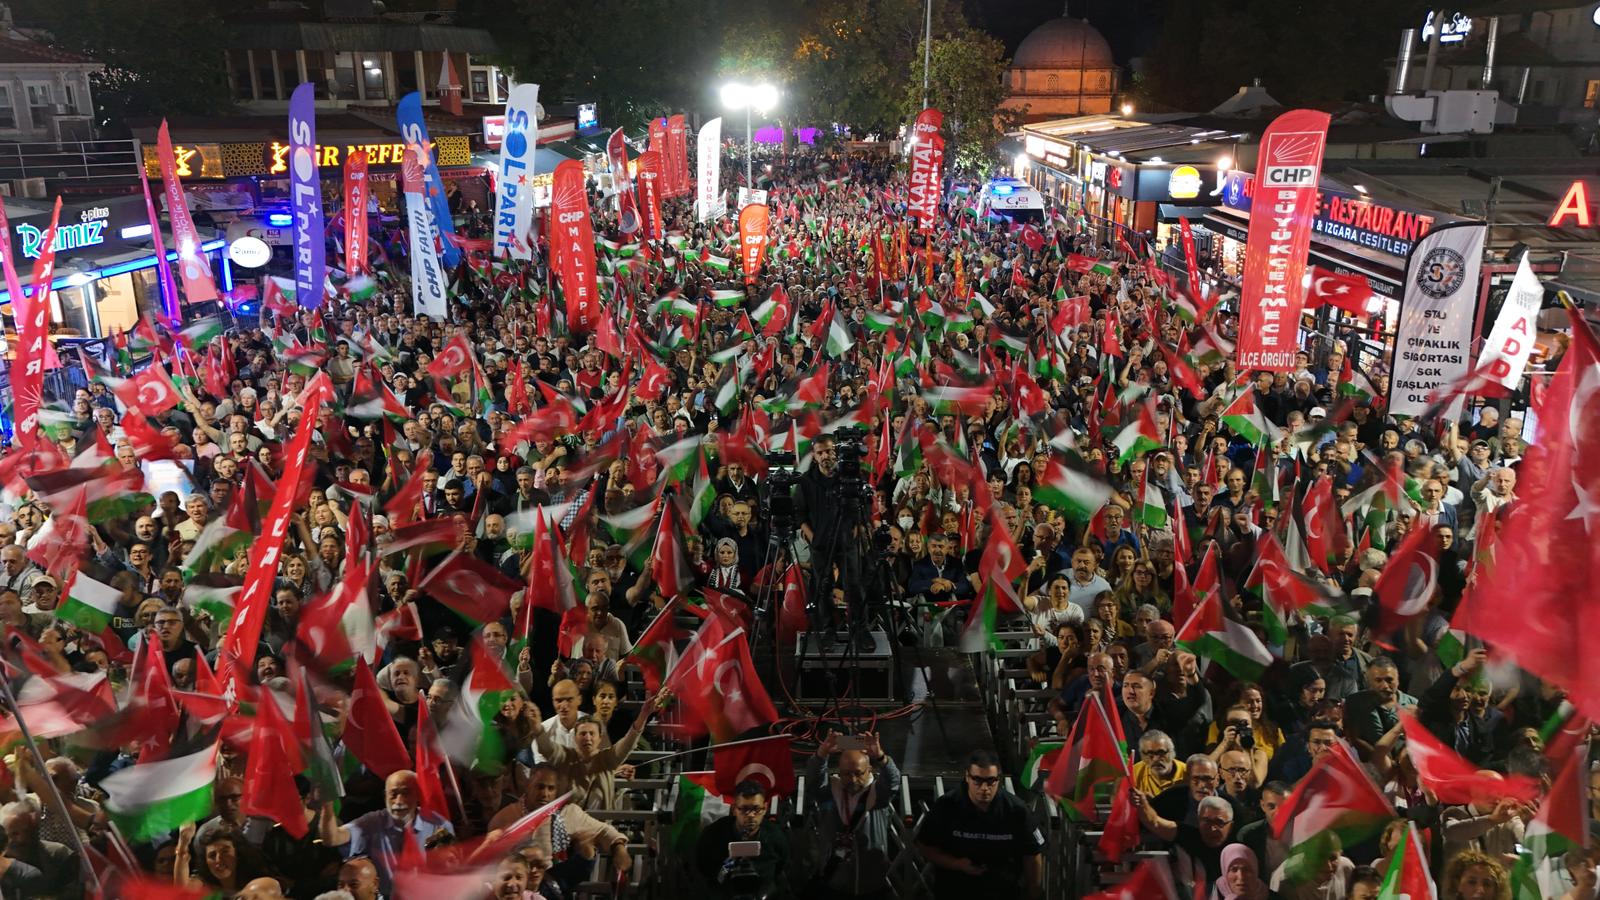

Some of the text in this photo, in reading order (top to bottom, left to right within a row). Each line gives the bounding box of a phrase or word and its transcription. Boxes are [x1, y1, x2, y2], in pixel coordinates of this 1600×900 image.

[908, 138, 933, 211] KARTAL
[1270, 168, 1312, 183] CHP
[559, 210, 584, 223] CHP
[1329, 195, 1435, 242] RESTAURANT
[1549, 181, 1590, 227] A
[1324, 221, 1358, 242] IZGARA
[423, 258, 442, 299] CHP
[568, 226, 588, 325] MALTEPE
[1367, 278, 1395, 295] ESTAURANT
[1416, 367, 1442, 377] SGK
